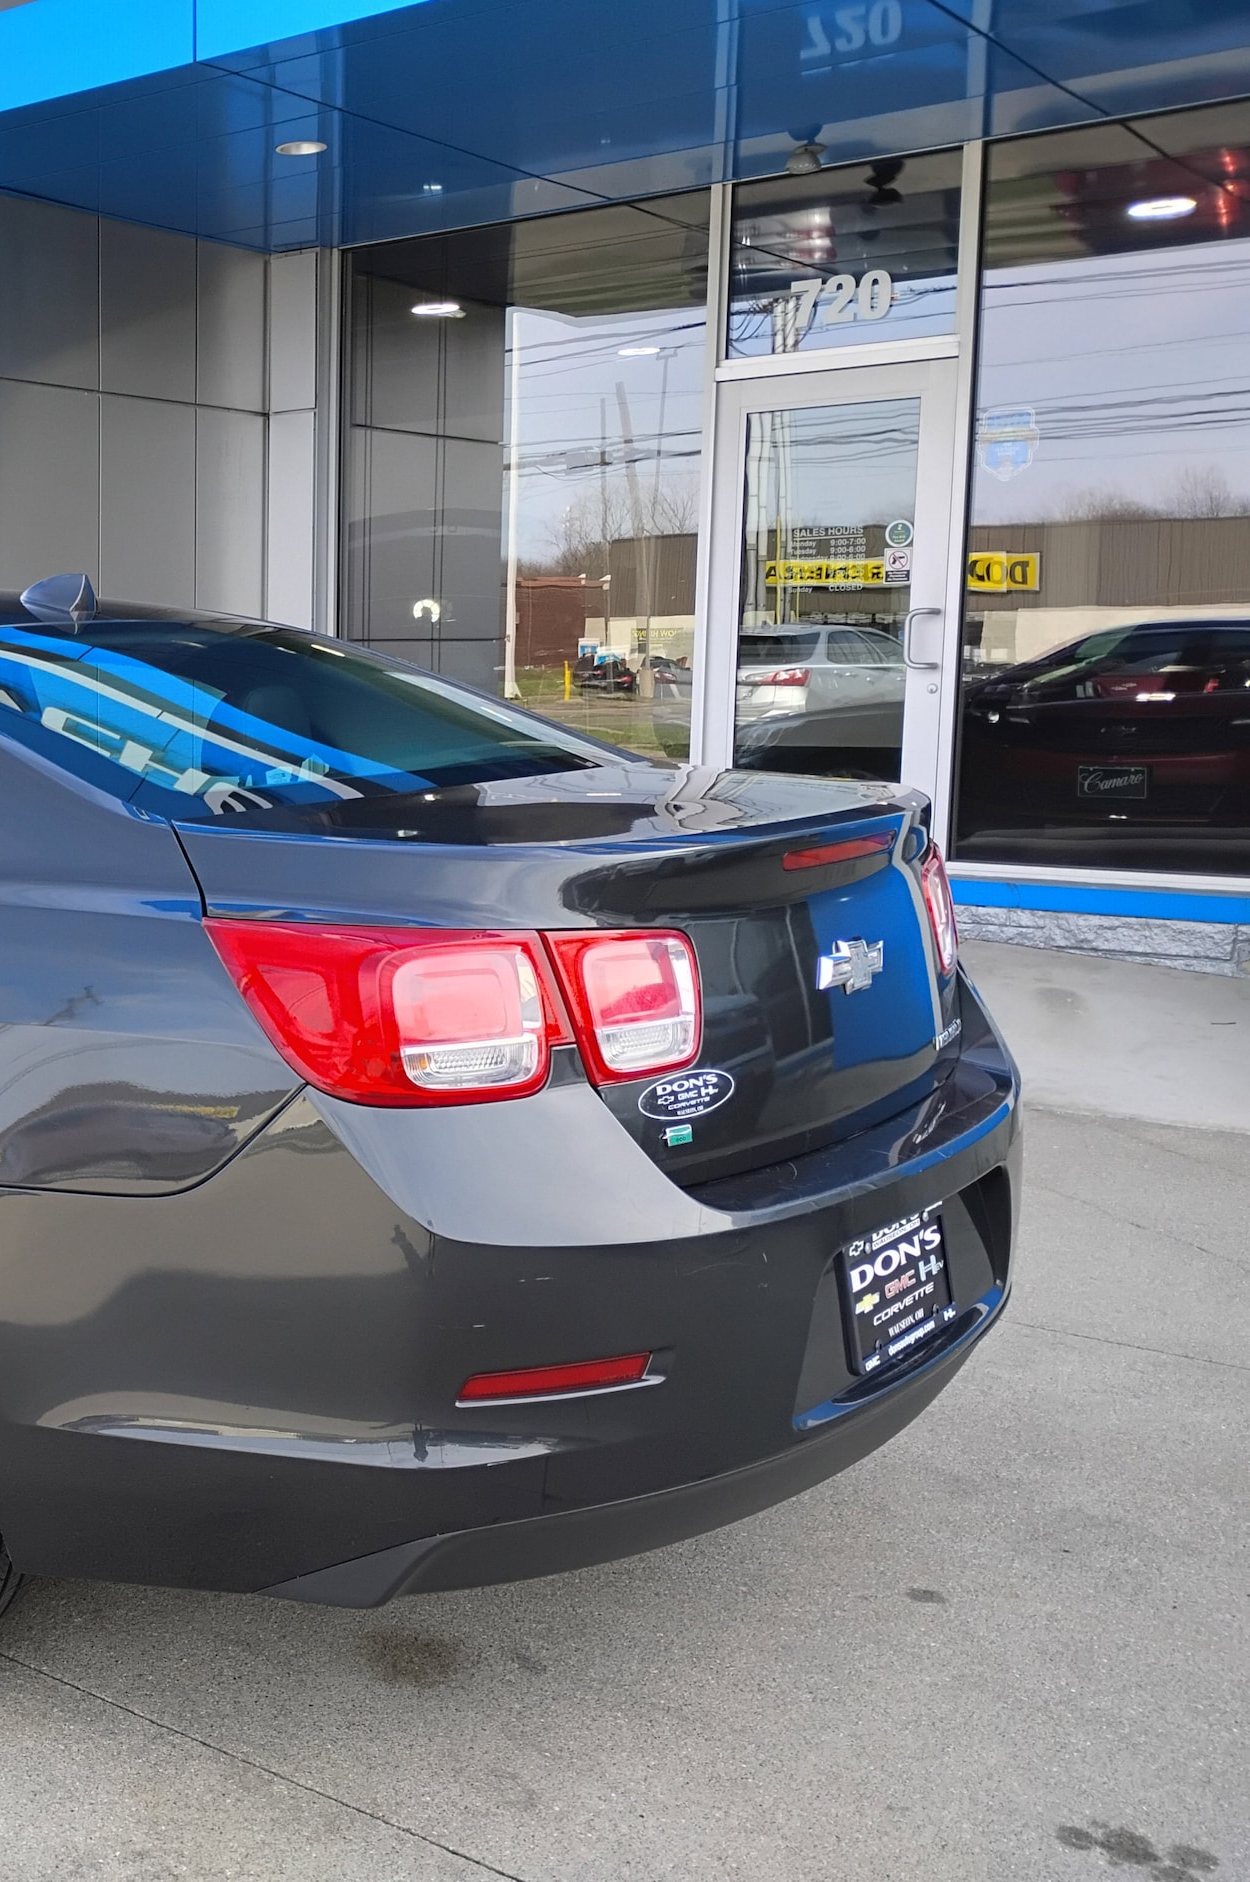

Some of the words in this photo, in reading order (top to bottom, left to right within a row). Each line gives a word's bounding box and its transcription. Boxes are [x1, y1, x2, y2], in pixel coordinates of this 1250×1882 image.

[791, 270, 892, 328] 720
[793, 527, 826, 537] SALES
[828, 526, 864, 536] HOURS
[829, 538, 867, 546] 9:00-7:00
[828, 583, 863, 592] CLOSED
[1079, 771, 1144, 794] Camaro
[656, 1074, 718, 1096] DON'S
[677, 1090, 698, 1100] GMC
[850, 1225, 942, 1293] DON'S
[884, 1269, 917, 1299] GMC
[872, 1281, 935, 1326] CORVETTE
